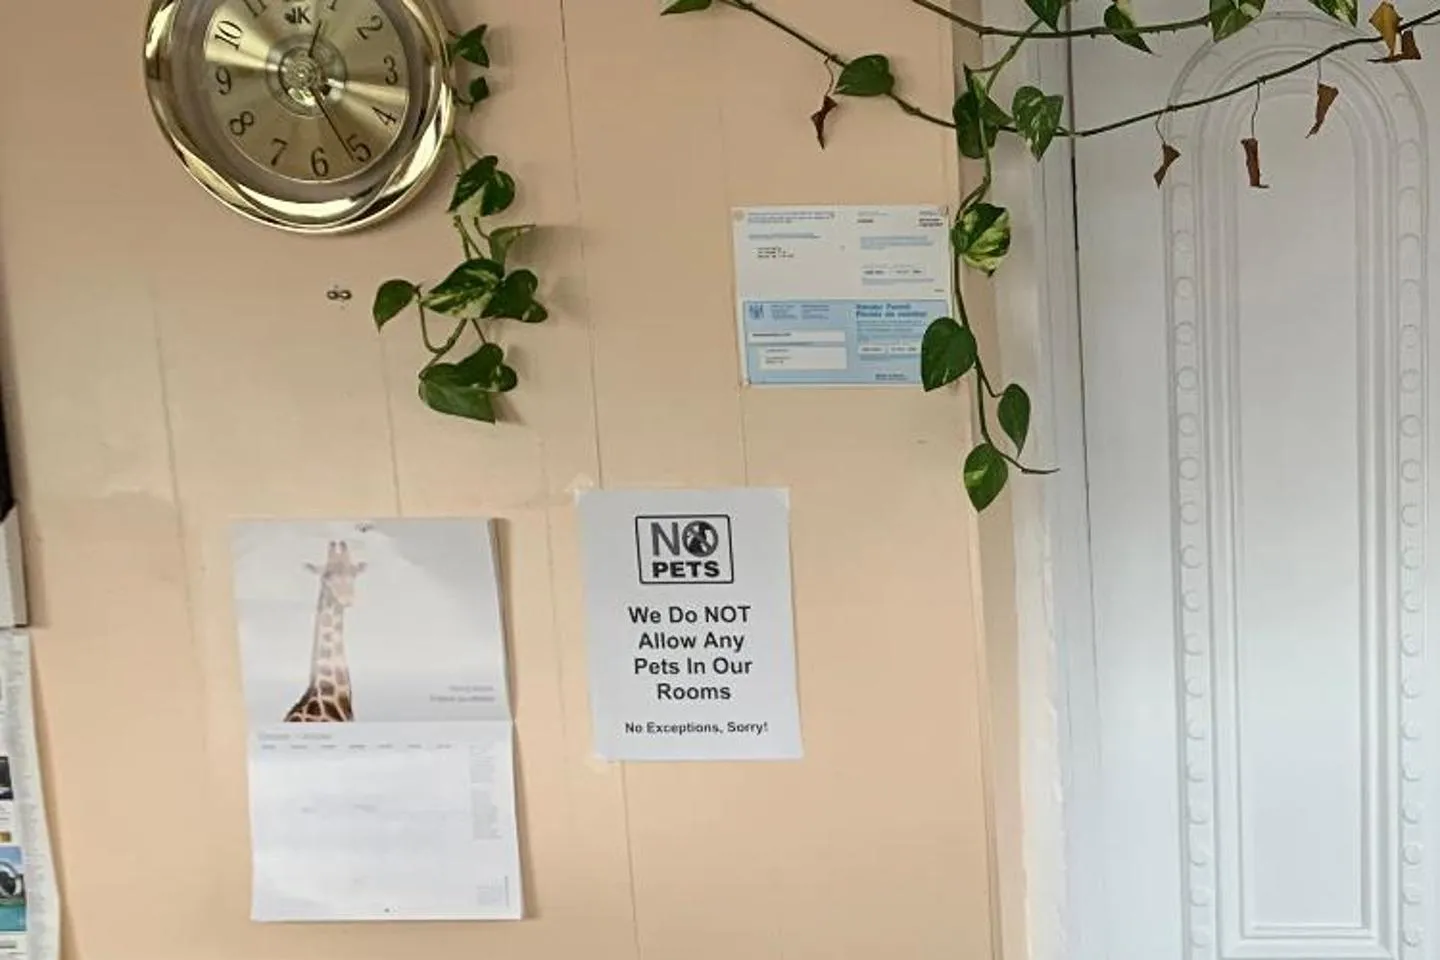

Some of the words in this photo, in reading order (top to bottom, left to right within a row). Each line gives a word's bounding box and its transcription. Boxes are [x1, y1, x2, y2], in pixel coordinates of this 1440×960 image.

[214, 20, 242, 50] 10
[357, 15, 383, 40] 2
[215, 69, 233, 96] 9
[383, 55, 398, 85] 3
[229, 111, 255, 137] 8
[372, 105, 397, 128] 4
[270, 138, 288, 167] 7
[349, 134, 372, 162] 5
[310, 148, 330, 178] 6
[650, 520, 719, 558] NO
[652, 561, 720, 578] PETS
[629, 607, 661, 624] We
[669, 606, 697, 623] Do
[704, 606, 751, 623] NOT
[638, 632, 696, 650] Allow
[703, 632, 744, 652] Any
[634, 658, 680, 675] Pets
[687, 658, 706, 675] In
[713, 657, 753, 675] Our
[657, 683, 731, 700] Rooms
[625, 722, 642, 734] No
[647, 722, 723, 736] Exceptions,
[727, 721, 769, 736] Sorry!
